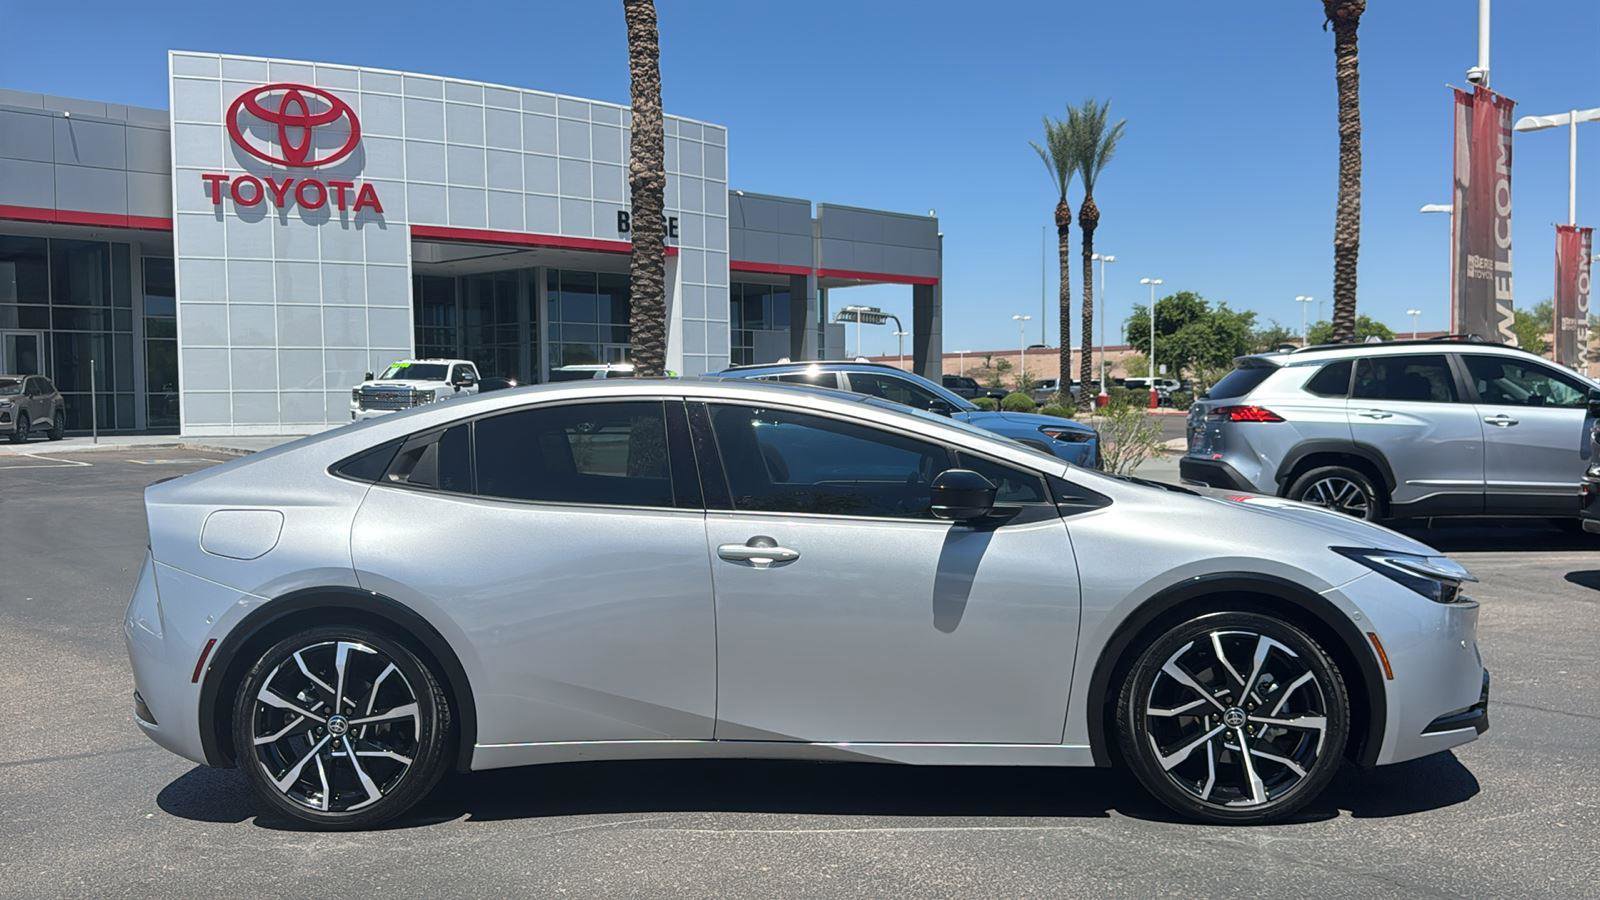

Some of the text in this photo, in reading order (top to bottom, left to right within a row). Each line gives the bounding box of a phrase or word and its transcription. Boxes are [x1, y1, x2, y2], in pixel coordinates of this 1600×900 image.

[202, 174, 383, 213] TOYOTA
[1495, 107, 1518, 347] WELCOME
[1577, 232, 1590, 368] WELCOME
